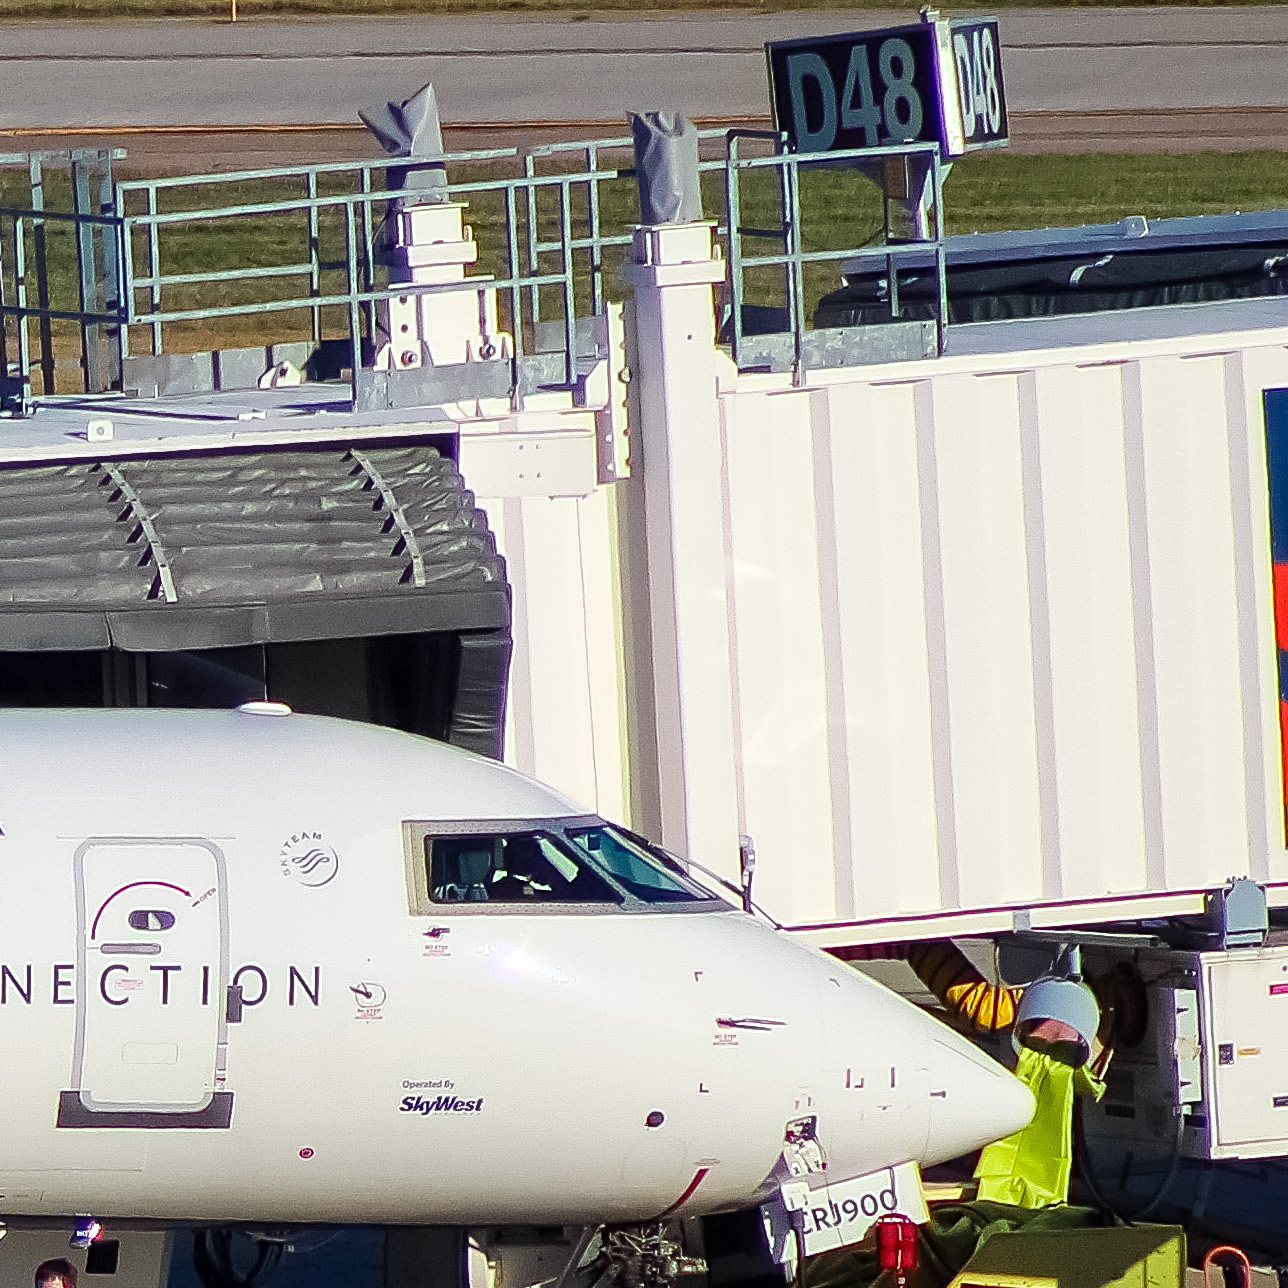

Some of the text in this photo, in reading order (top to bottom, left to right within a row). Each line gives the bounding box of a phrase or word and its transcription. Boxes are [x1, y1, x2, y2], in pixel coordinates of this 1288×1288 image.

[786, 37, 924, 152] D48
[953, 27, 1001, 138] D48
[279, 831, 322, 877] SKYTEAM
[399, 1095, 484, 1115] SkyWest
[402, 1080, 443, 1090] Operated
